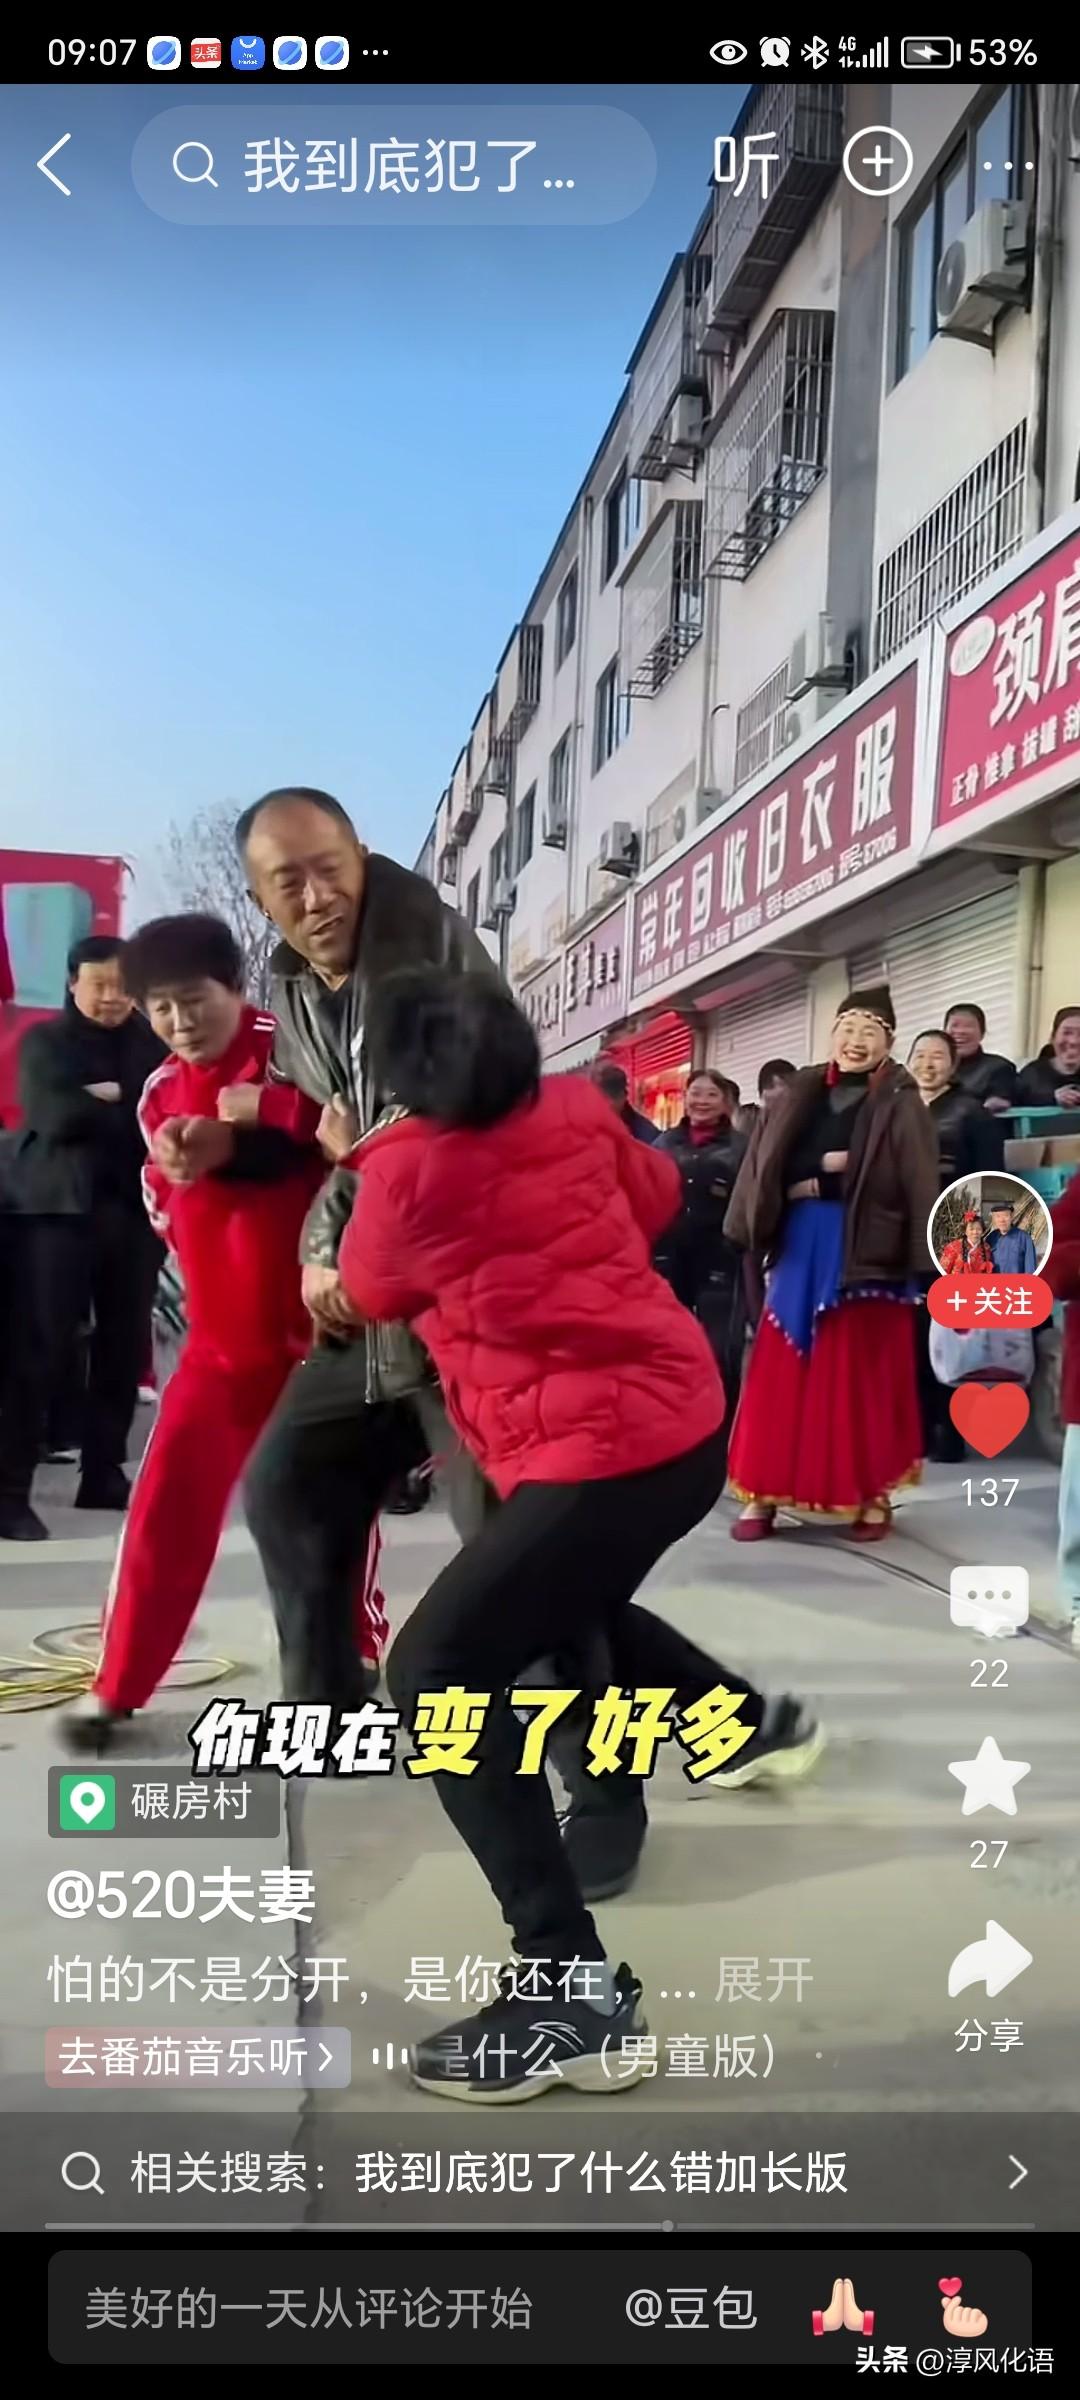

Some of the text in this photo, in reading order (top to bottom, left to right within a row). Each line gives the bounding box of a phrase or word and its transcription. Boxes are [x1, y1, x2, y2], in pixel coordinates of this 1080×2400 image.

[638, 709, 896, 966] 常年回收旧衣服
